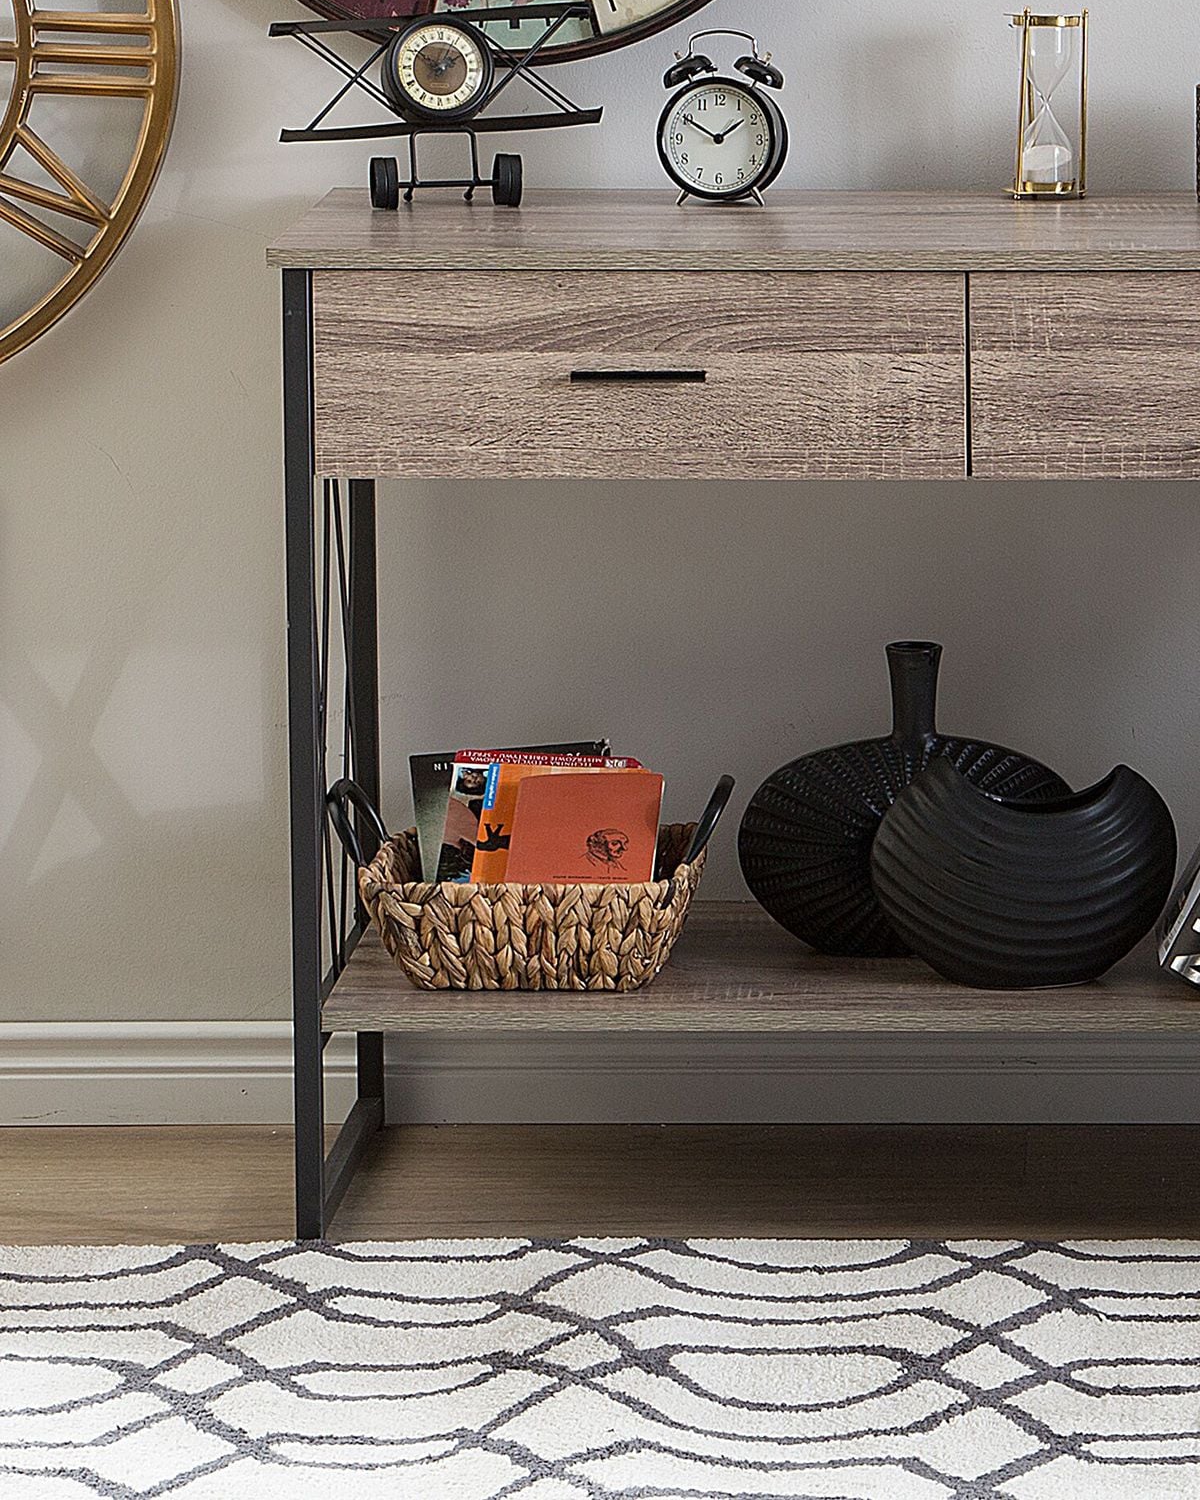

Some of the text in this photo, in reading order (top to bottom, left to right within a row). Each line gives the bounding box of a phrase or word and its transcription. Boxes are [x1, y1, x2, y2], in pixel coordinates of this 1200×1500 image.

[28, 10, 155, 98] III
[697, 99, 707, 111] 11
[714, 94, 726, 106] 12
[736, 99, 741, 111] 1
[683, 113, 693, 125] 10
[750, 113, 758, 125] 2
[675, 133, 683, 145] 9
[756, 134, 763, 146] 3
[681, 152, 689, 165] 8
[748, 154, 757, 165] 4
[696, 168, 703, 179] 7
[715, 172, 723, 184] 6
[737, 168, 744, 180] 5
